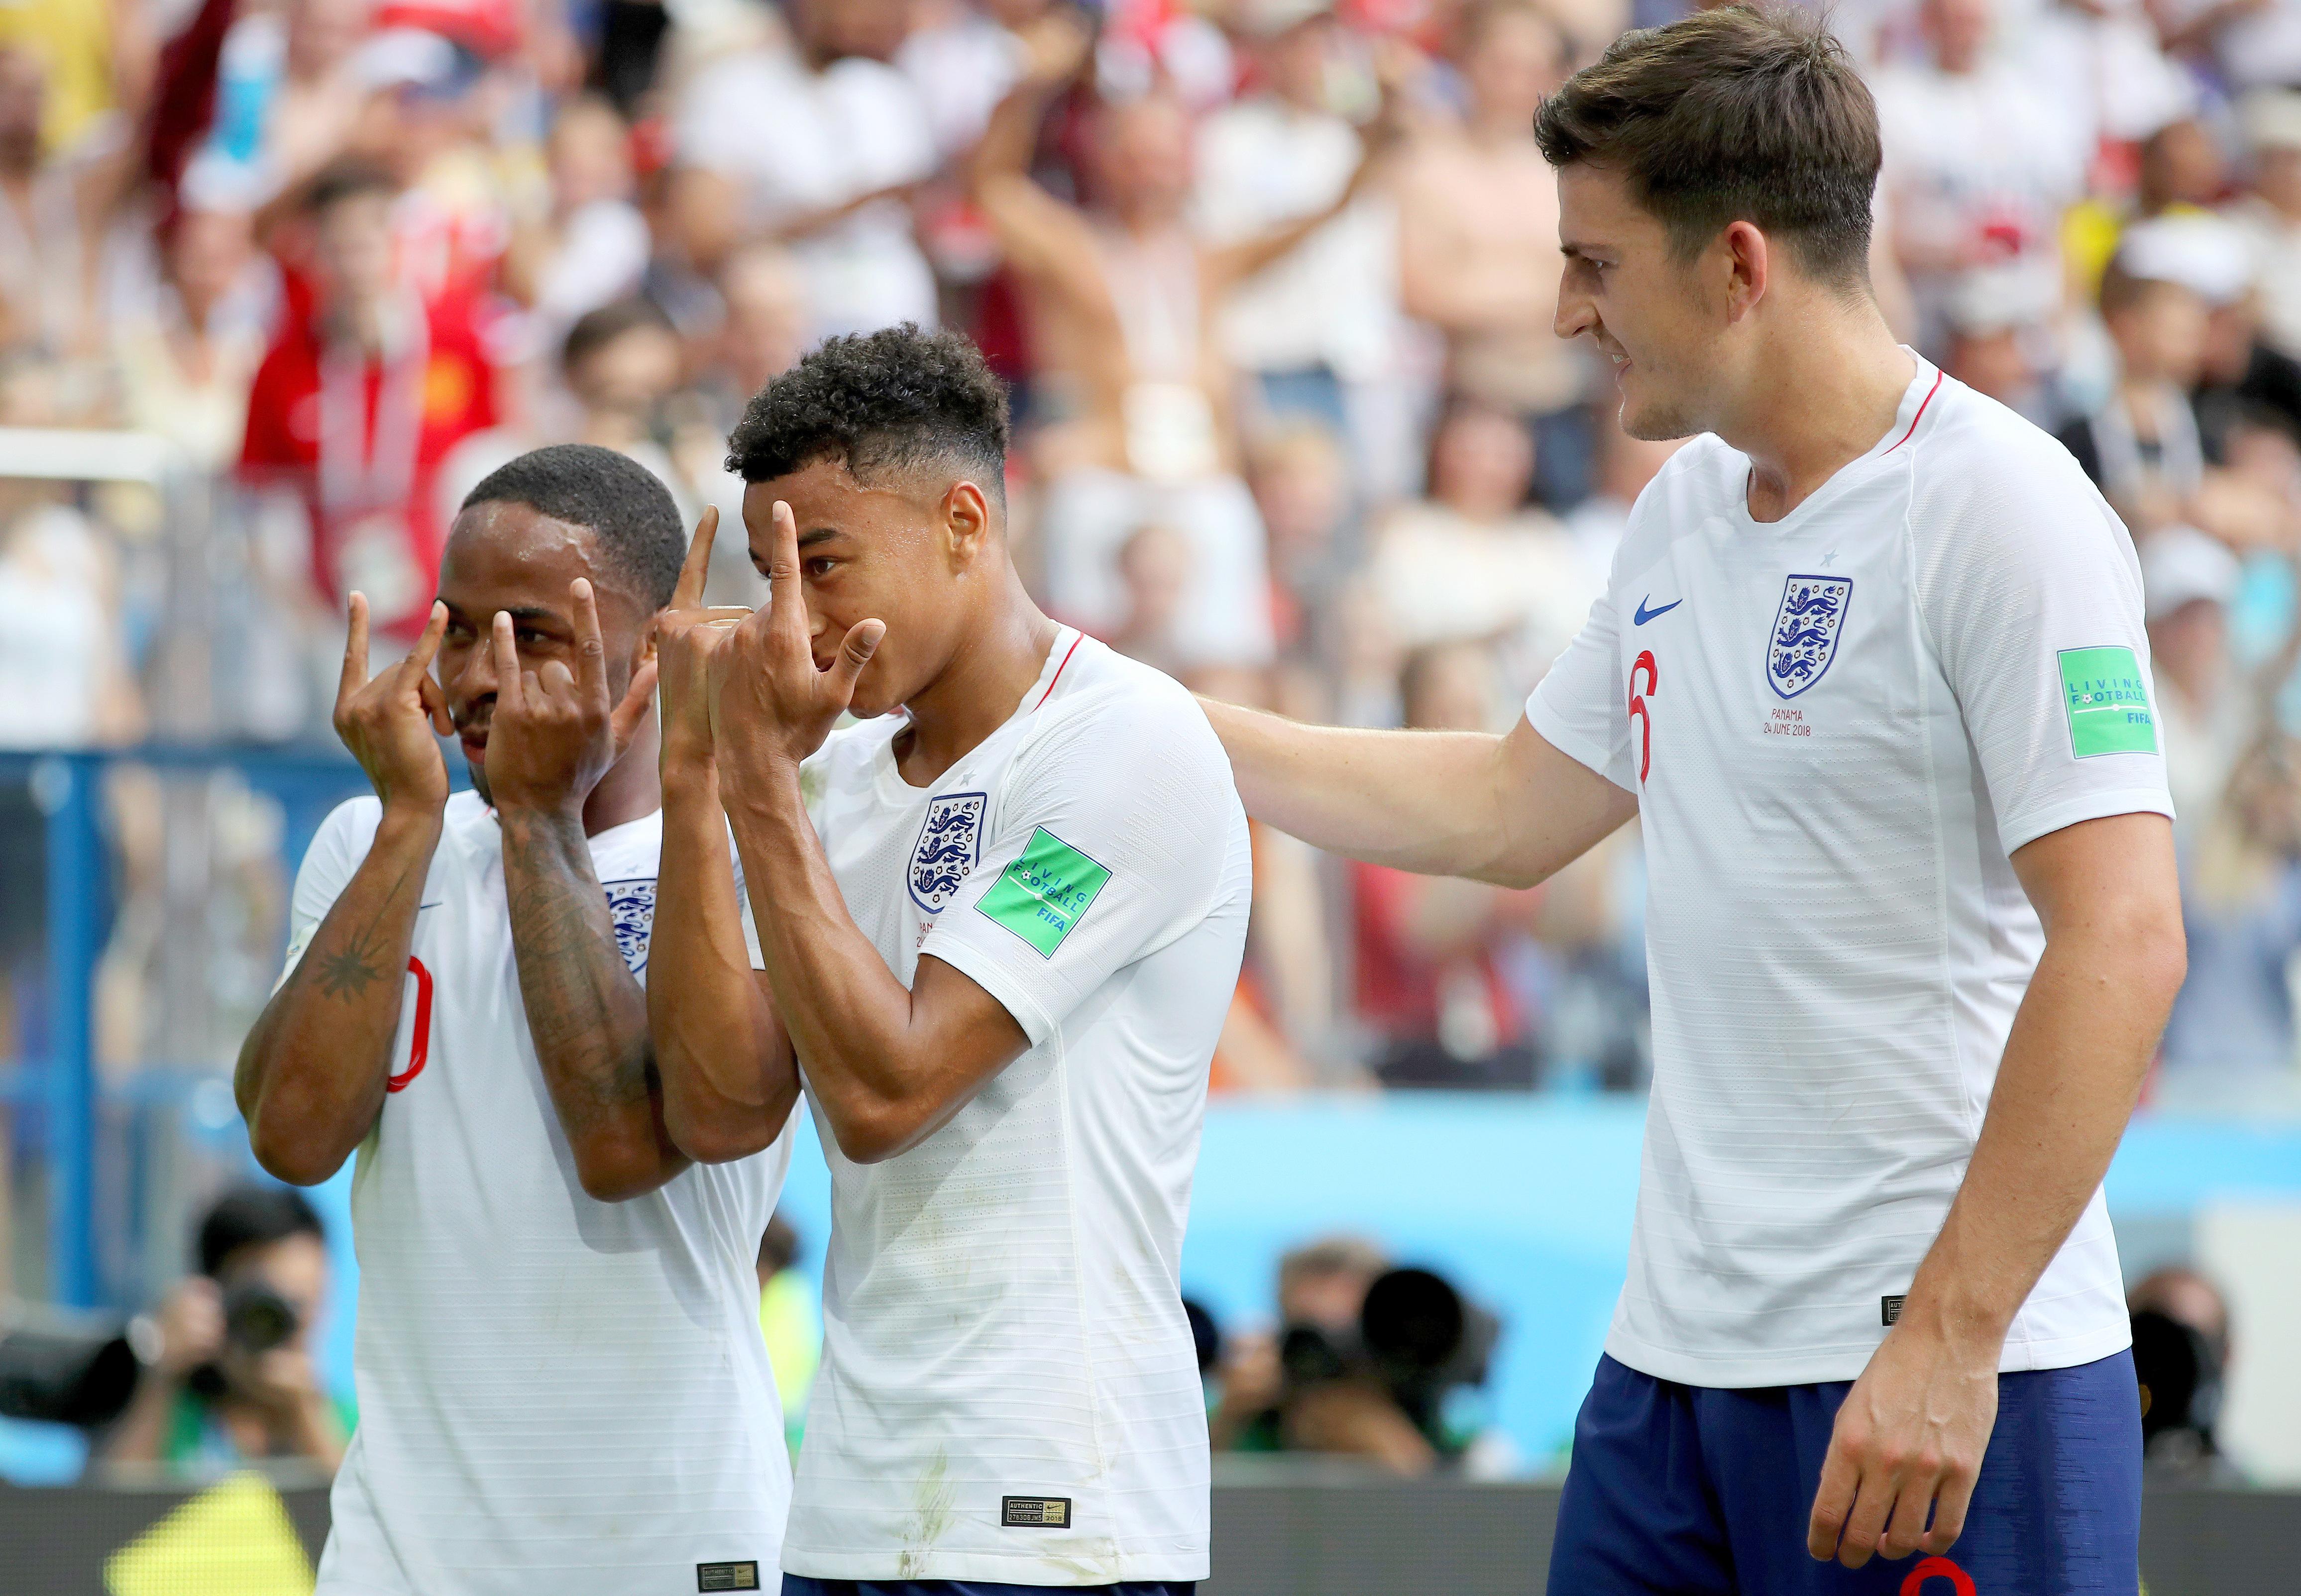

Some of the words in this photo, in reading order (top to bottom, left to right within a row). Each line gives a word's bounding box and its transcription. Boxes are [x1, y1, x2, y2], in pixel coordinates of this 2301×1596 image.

[2070, 678, 2143, 693] LIVING
[1629, 650, 1658, 783] 6
[1771, 708, 1803, 722] PANAMA
[2127, 712, 2152, 725] FIFA
[1764, 722, 1772, 734] 24
[1773, 723, 1791, 735] JUNE
[1792, 725, 1811, 737] 2018
[1019, 856, 1087, 903] LIVING
[1036, 907, 1067, 932] FIFA
